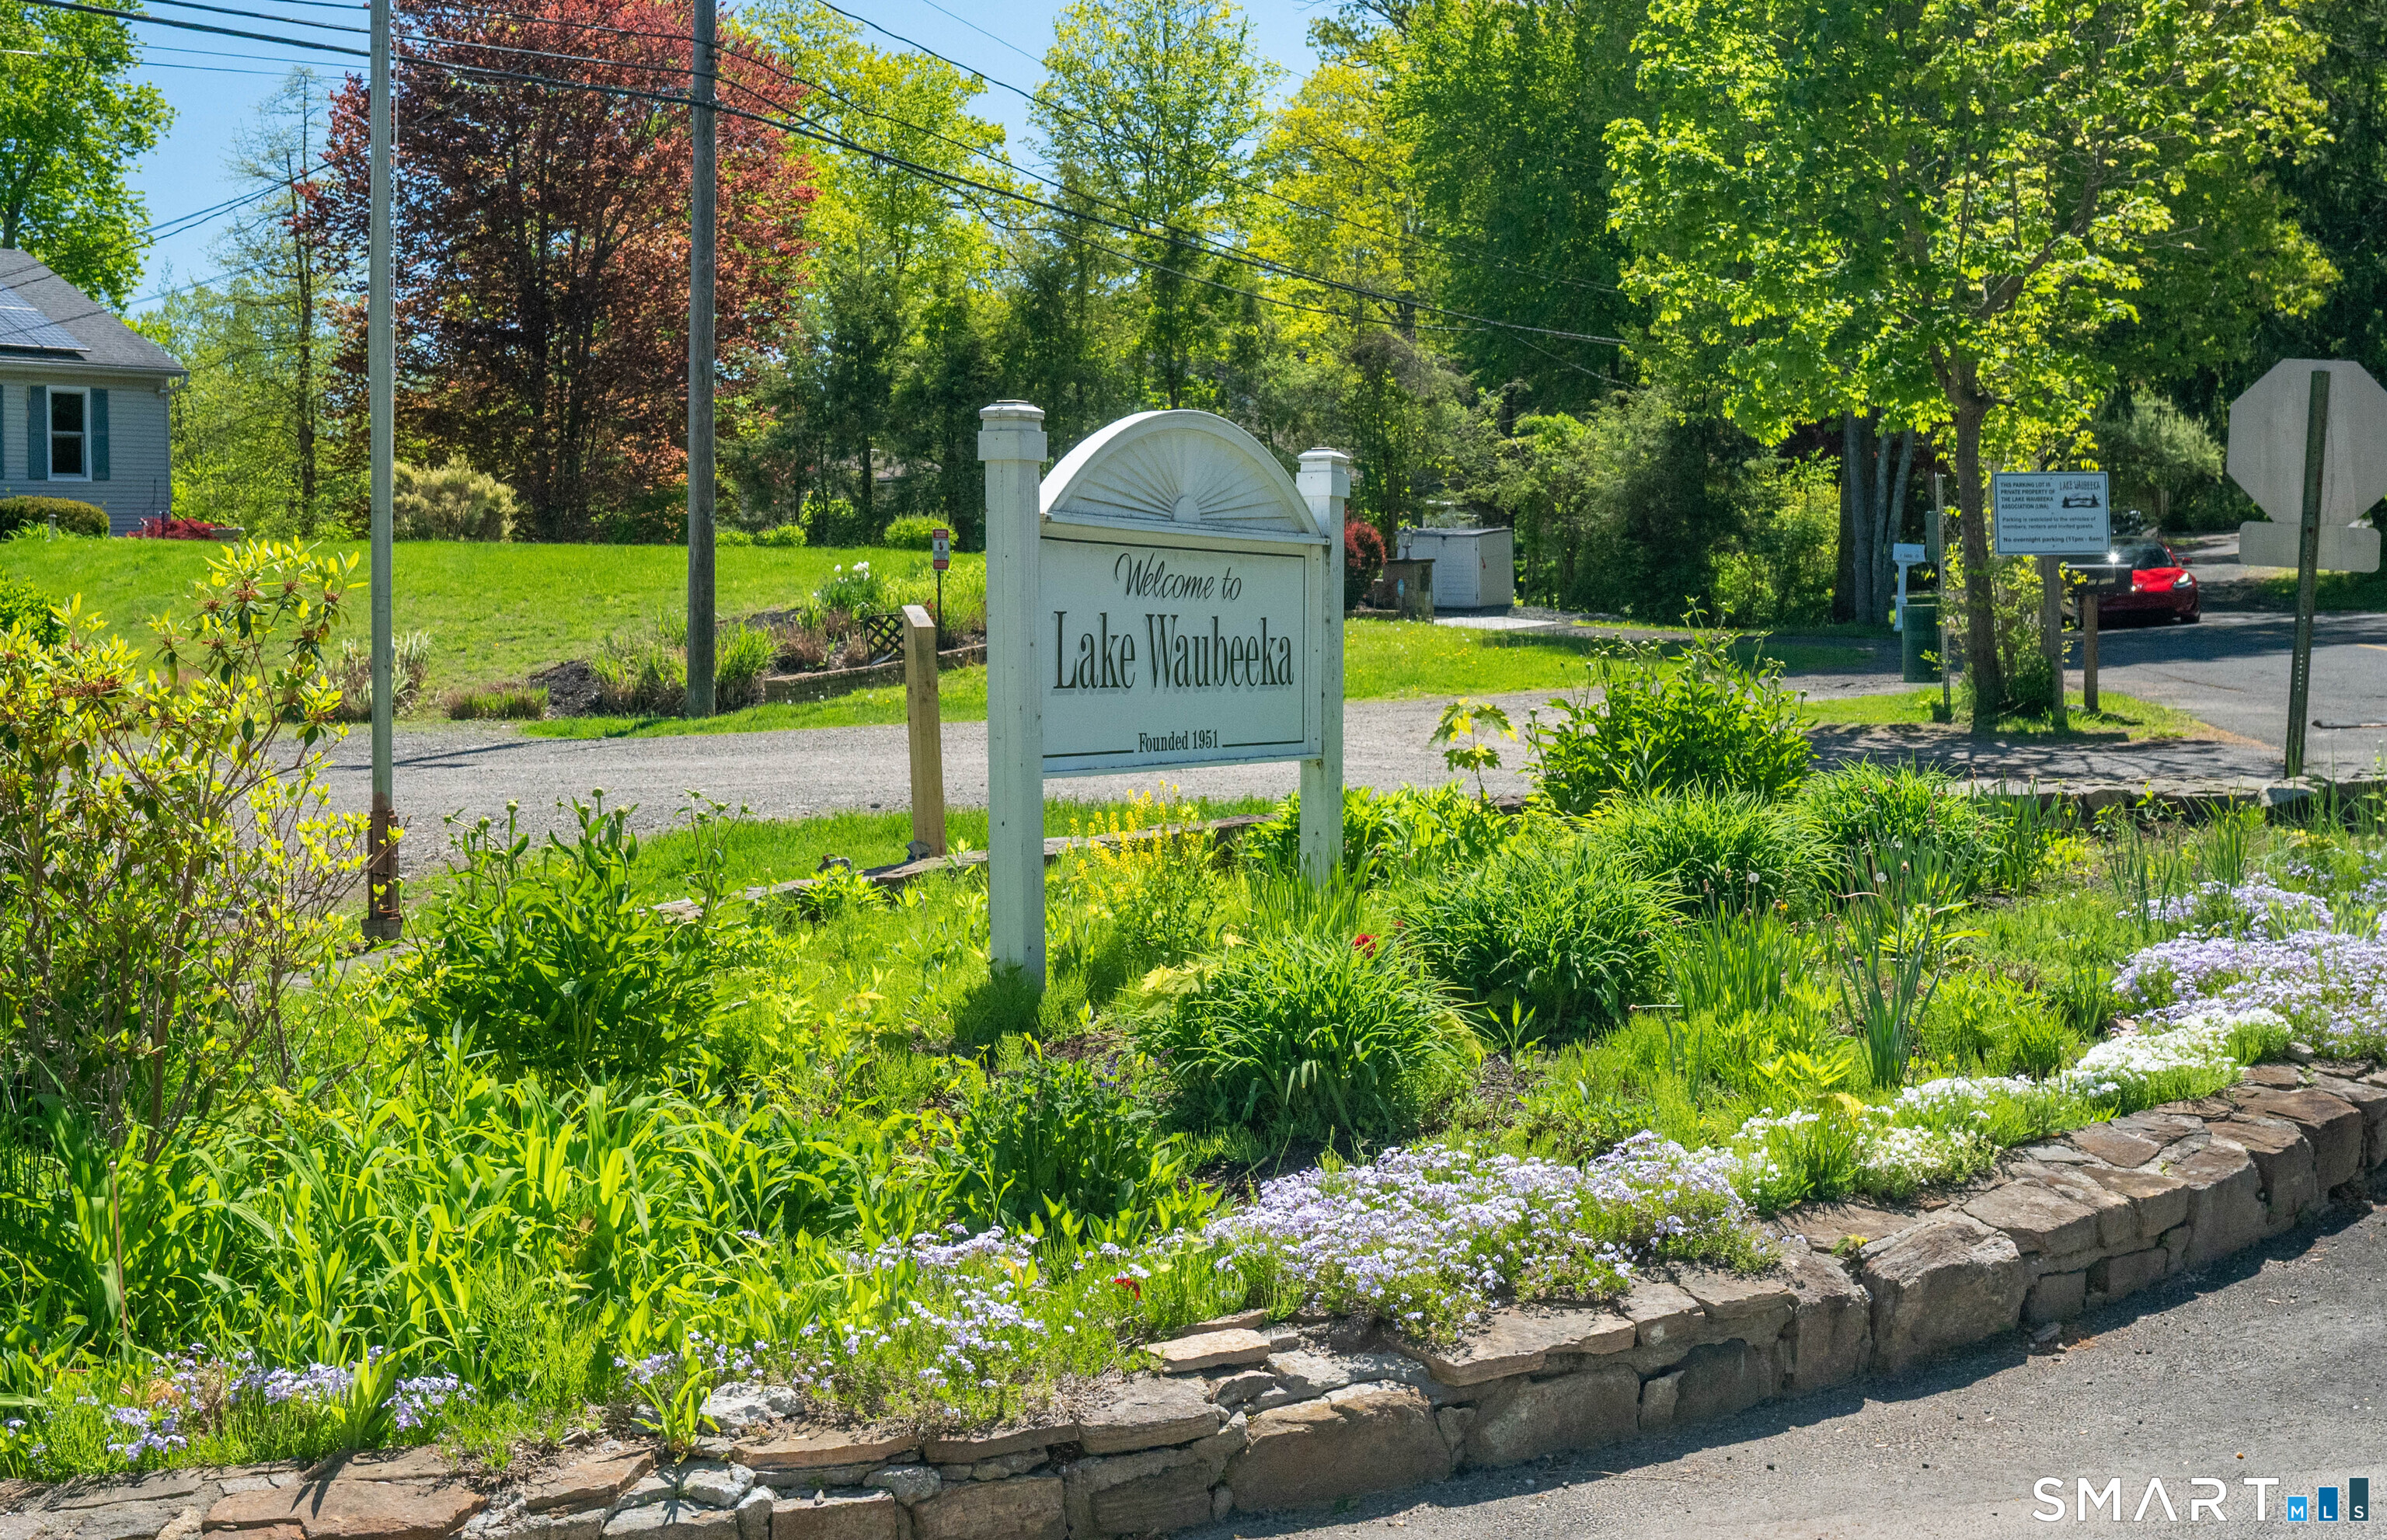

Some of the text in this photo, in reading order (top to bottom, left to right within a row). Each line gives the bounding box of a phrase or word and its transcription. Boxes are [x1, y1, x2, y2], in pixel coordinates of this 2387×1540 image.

[2059, 480, 2101, 490] LAKE WAUBEEKA
[1113, 551, 1242, 601] Welcome to
[1051, 610, 1295, 690] Lake Waubeeka
[1138, 729, 1218, 753] Founded 1951
